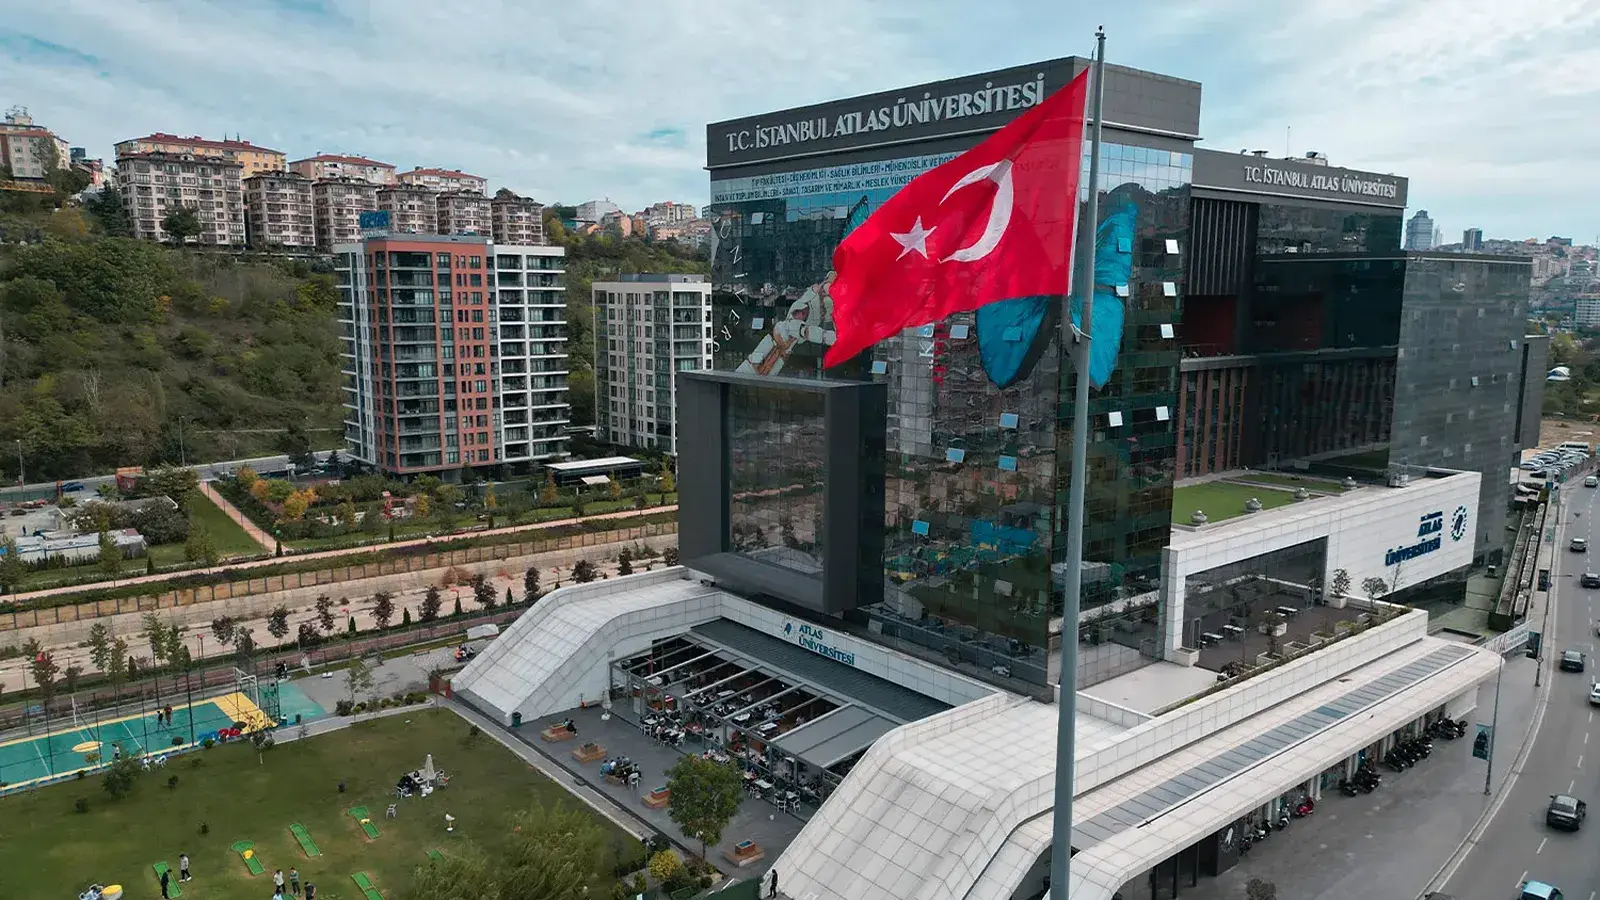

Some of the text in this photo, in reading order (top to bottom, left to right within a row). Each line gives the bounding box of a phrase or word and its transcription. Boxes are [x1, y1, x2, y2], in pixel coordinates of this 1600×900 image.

[726, 72, 1045, 152] T.C. İSTANBUL ATLAS ÜNİVERSİTESİ
[852, 164, 881, 176] BİLİMLERİ
[885, 156, 928, 172] MÜHENDİSLİK
[929, 157, 938, 167] VE
[865, 176, 889, 188] MESLEK
[1244, 164, 1397, 198] T.C. İSTANBUL ATLAS ÜNİVERSİTESİ
[1417, 518, 1443, 537] ATLAS
[799, 624, 823, 640] ATLAS
[799, 634, 855, 665] ÜNİVERSİTESİ
